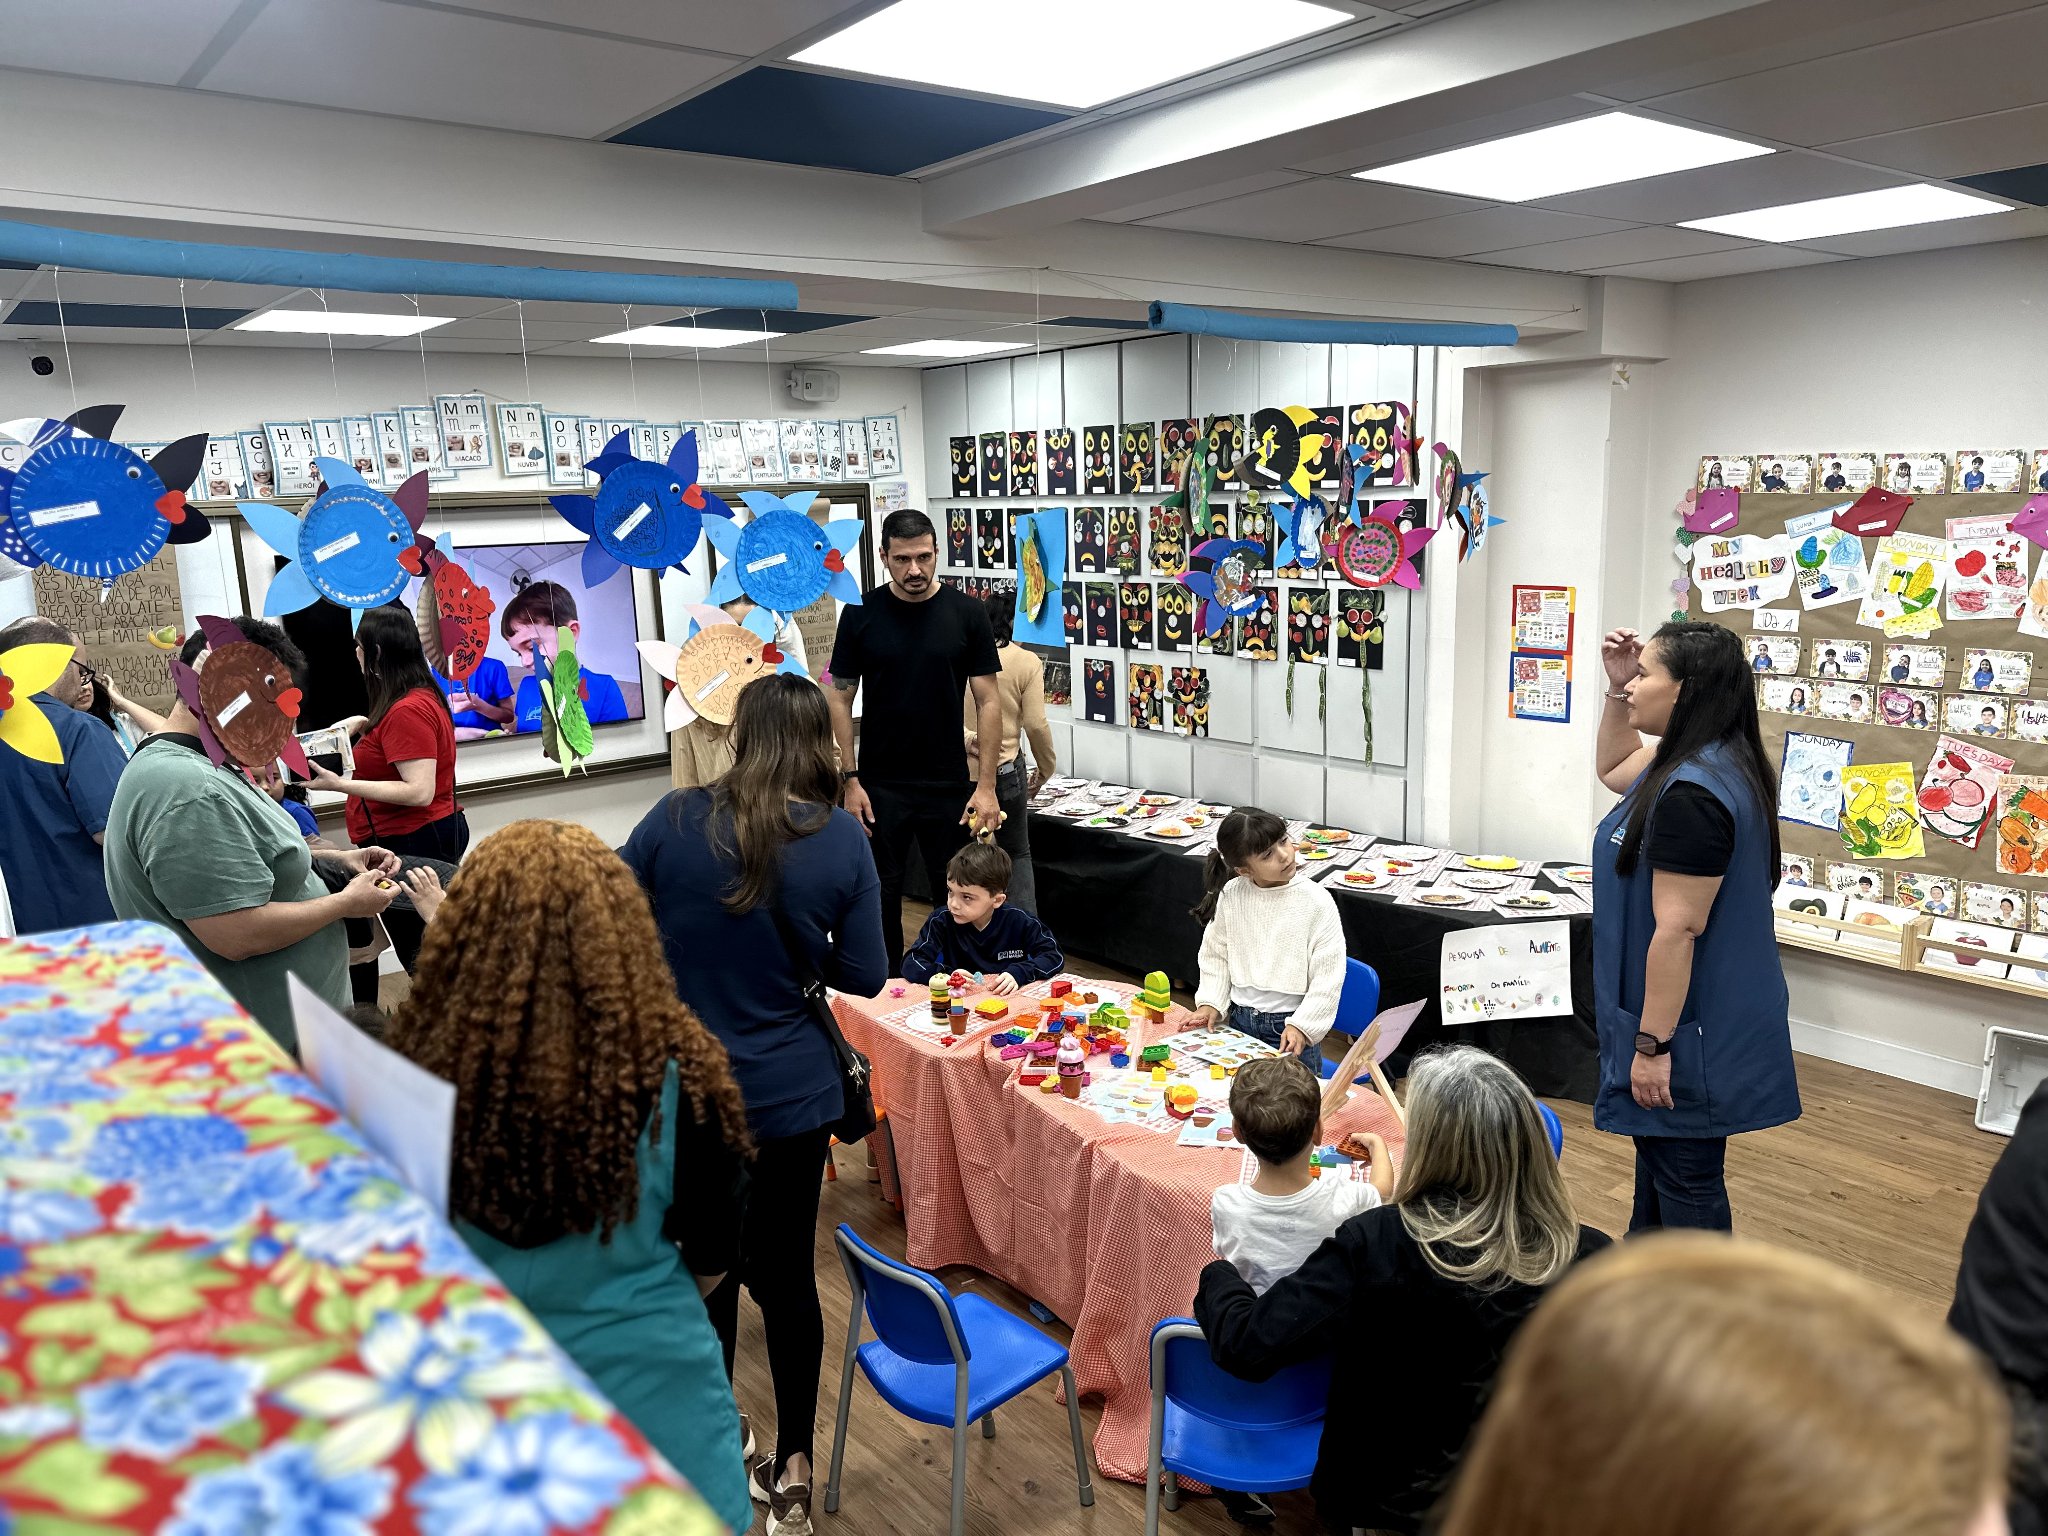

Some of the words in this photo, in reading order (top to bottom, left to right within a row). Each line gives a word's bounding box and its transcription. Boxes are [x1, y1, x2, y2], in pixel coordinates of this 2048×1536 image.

[444, 402, 459, 415] M
[466, 404, 479, 415] m
[412, 413, 420, 426] L
[507, 410, 517, 422] N
[527, 412, 535, 422] n
[356, 423, 361, 436] J
[384, 419, 394, 432] K
[555, 421, 564, 432] O
[590, 425, 597, 436] P
[714, 427, 723, 437] U
[732, 429, 739, 437] u
[818, 426, 825, 437] X
[848, 425, 853, 435] Y
[873, 422, 879, 431] Z
[277, 429, 290, 441] H
[301, 427, 312, 440] h
[645, 430, 652, 441] R
[663, 430, 670, 441] S
[250, 436, 263, 450] G
[1, 447, 15, 462] C
[210, 444, 218, 457] F
[1885, 536, 1938, 555] MONDAY
[65, 574, 85, 590] NA
[39, 590, 65, 604] QUE
[129, 587, 142, 601] DE
[75, 604, 87, 617] DE
[92, 600, 163, 616] CHOCOLATE
[172, 598, 181, 611] E
[95, 616, 109, 630] DE
[1785, 619, 1793, 630] A
[98, 631, 107, 645] E
[113, 628, 145, 643] MATE
[117, 656, 143, 670] UMA
[1798, 735, 1843, 749] SUNDAY
[1946, 740, 2002, 766] TUESDAY
[1846, 766, 1893, 777] MONDAY
[1448, 949, 1486, 961] PESQUISA
